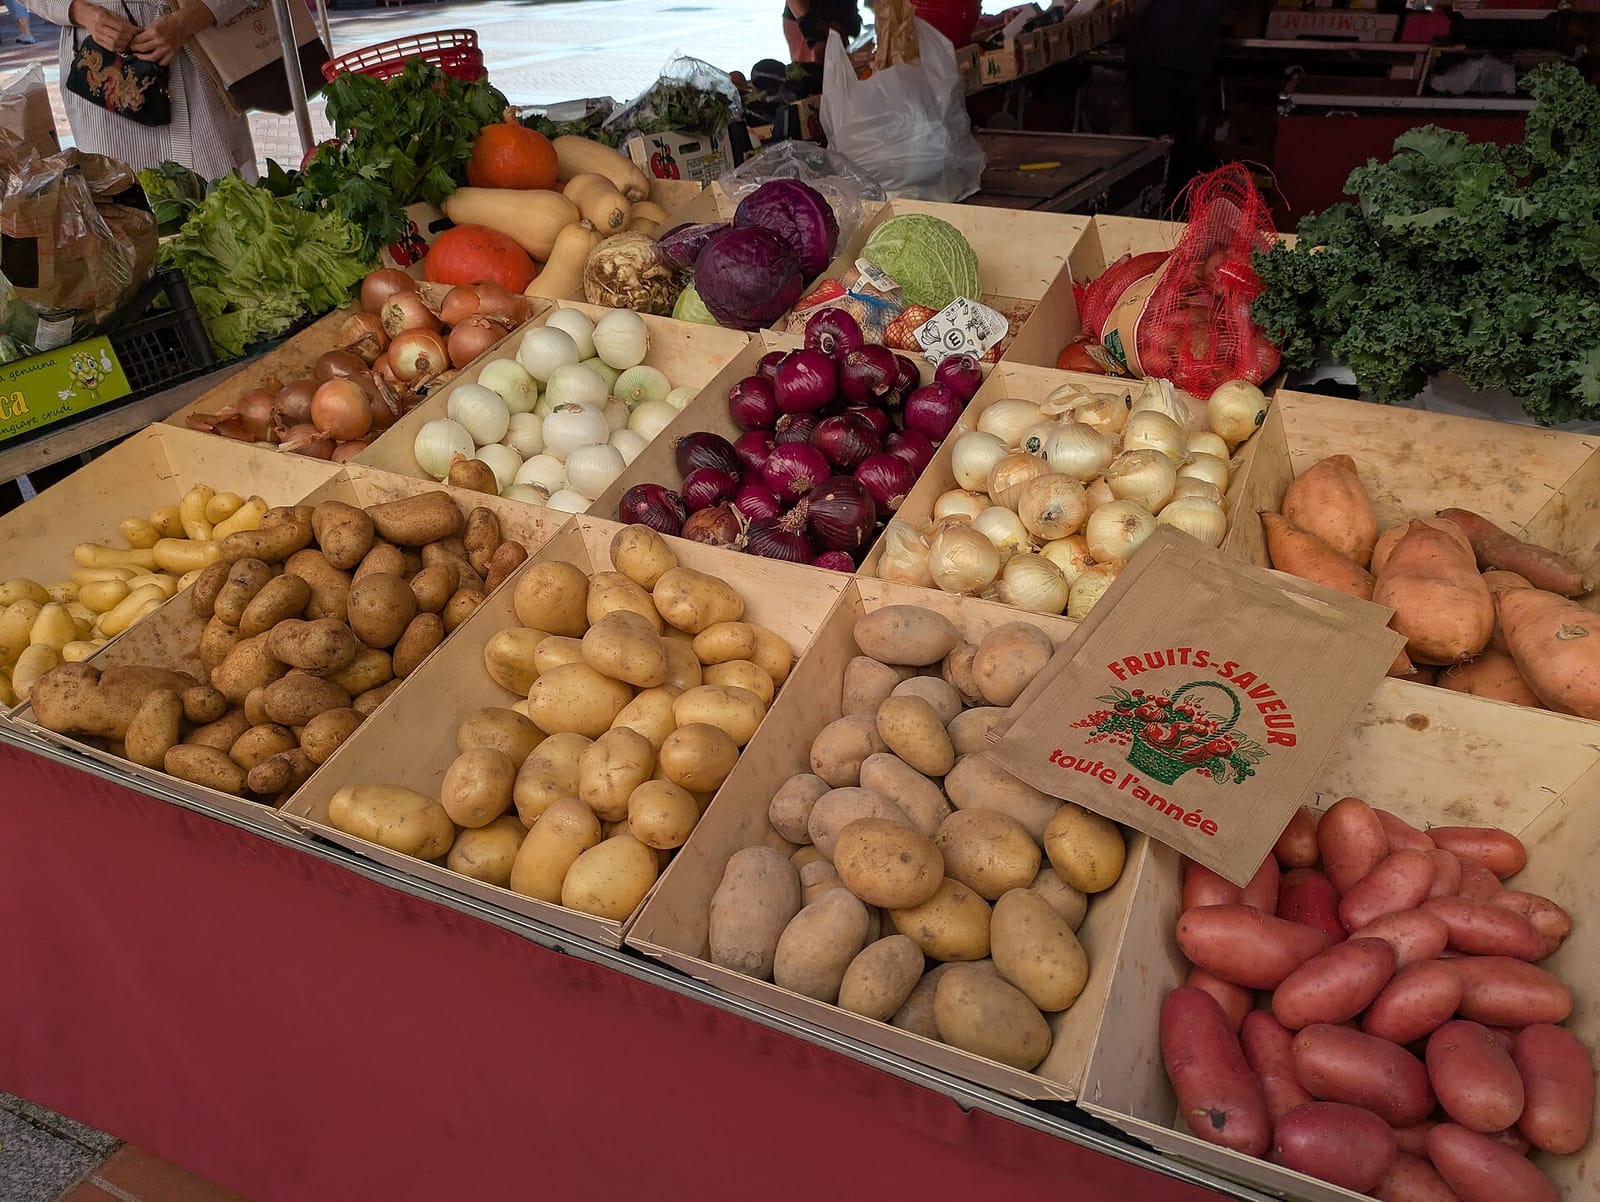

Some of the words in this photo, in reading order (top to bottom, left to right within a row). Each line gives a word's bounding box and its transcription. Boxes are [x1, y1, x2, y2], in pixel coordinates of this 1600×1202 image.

[9, 359, 57, 382] genuina
[42, 401, 73, 420] crudi
[1106, 647, 1298, 748] FRUITS-SAVEUR
[1048, 748, 1118, 784] toute
[1117, 774, 1219, 837] l'année
